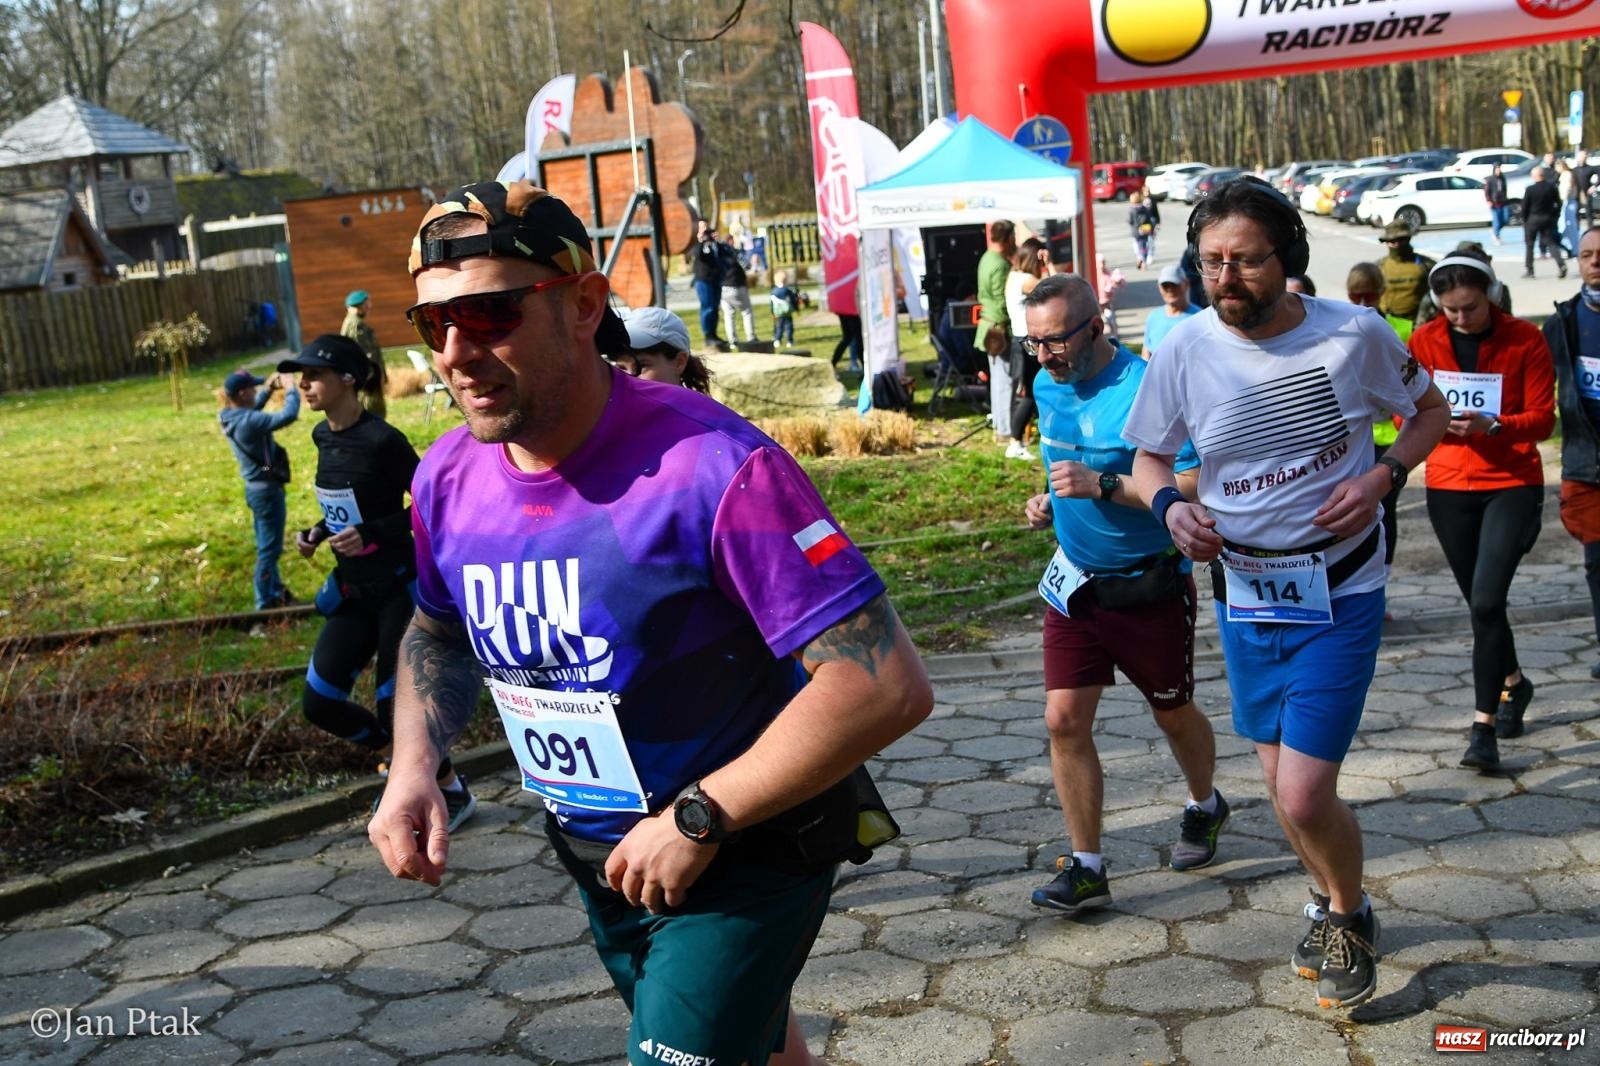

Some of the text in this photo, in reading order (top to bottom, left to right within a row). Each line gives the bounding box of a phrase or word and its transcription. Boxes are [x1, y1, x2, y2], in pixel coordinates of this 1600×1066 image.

[1260, 10, 1451, 55] RACIBÓRZ
[1446, 389, 1486, 408] 016
[1222, 479, 1251, 496] BIEG
[1254, 466, 1308, 491] ZBÓJA
[1248, 578, 1304, 604] 114
[511, 694, 533, 709] BIEG
[534, 698, 602, 715] TWARDZIELA
[524, 727, 601, 779] 091
